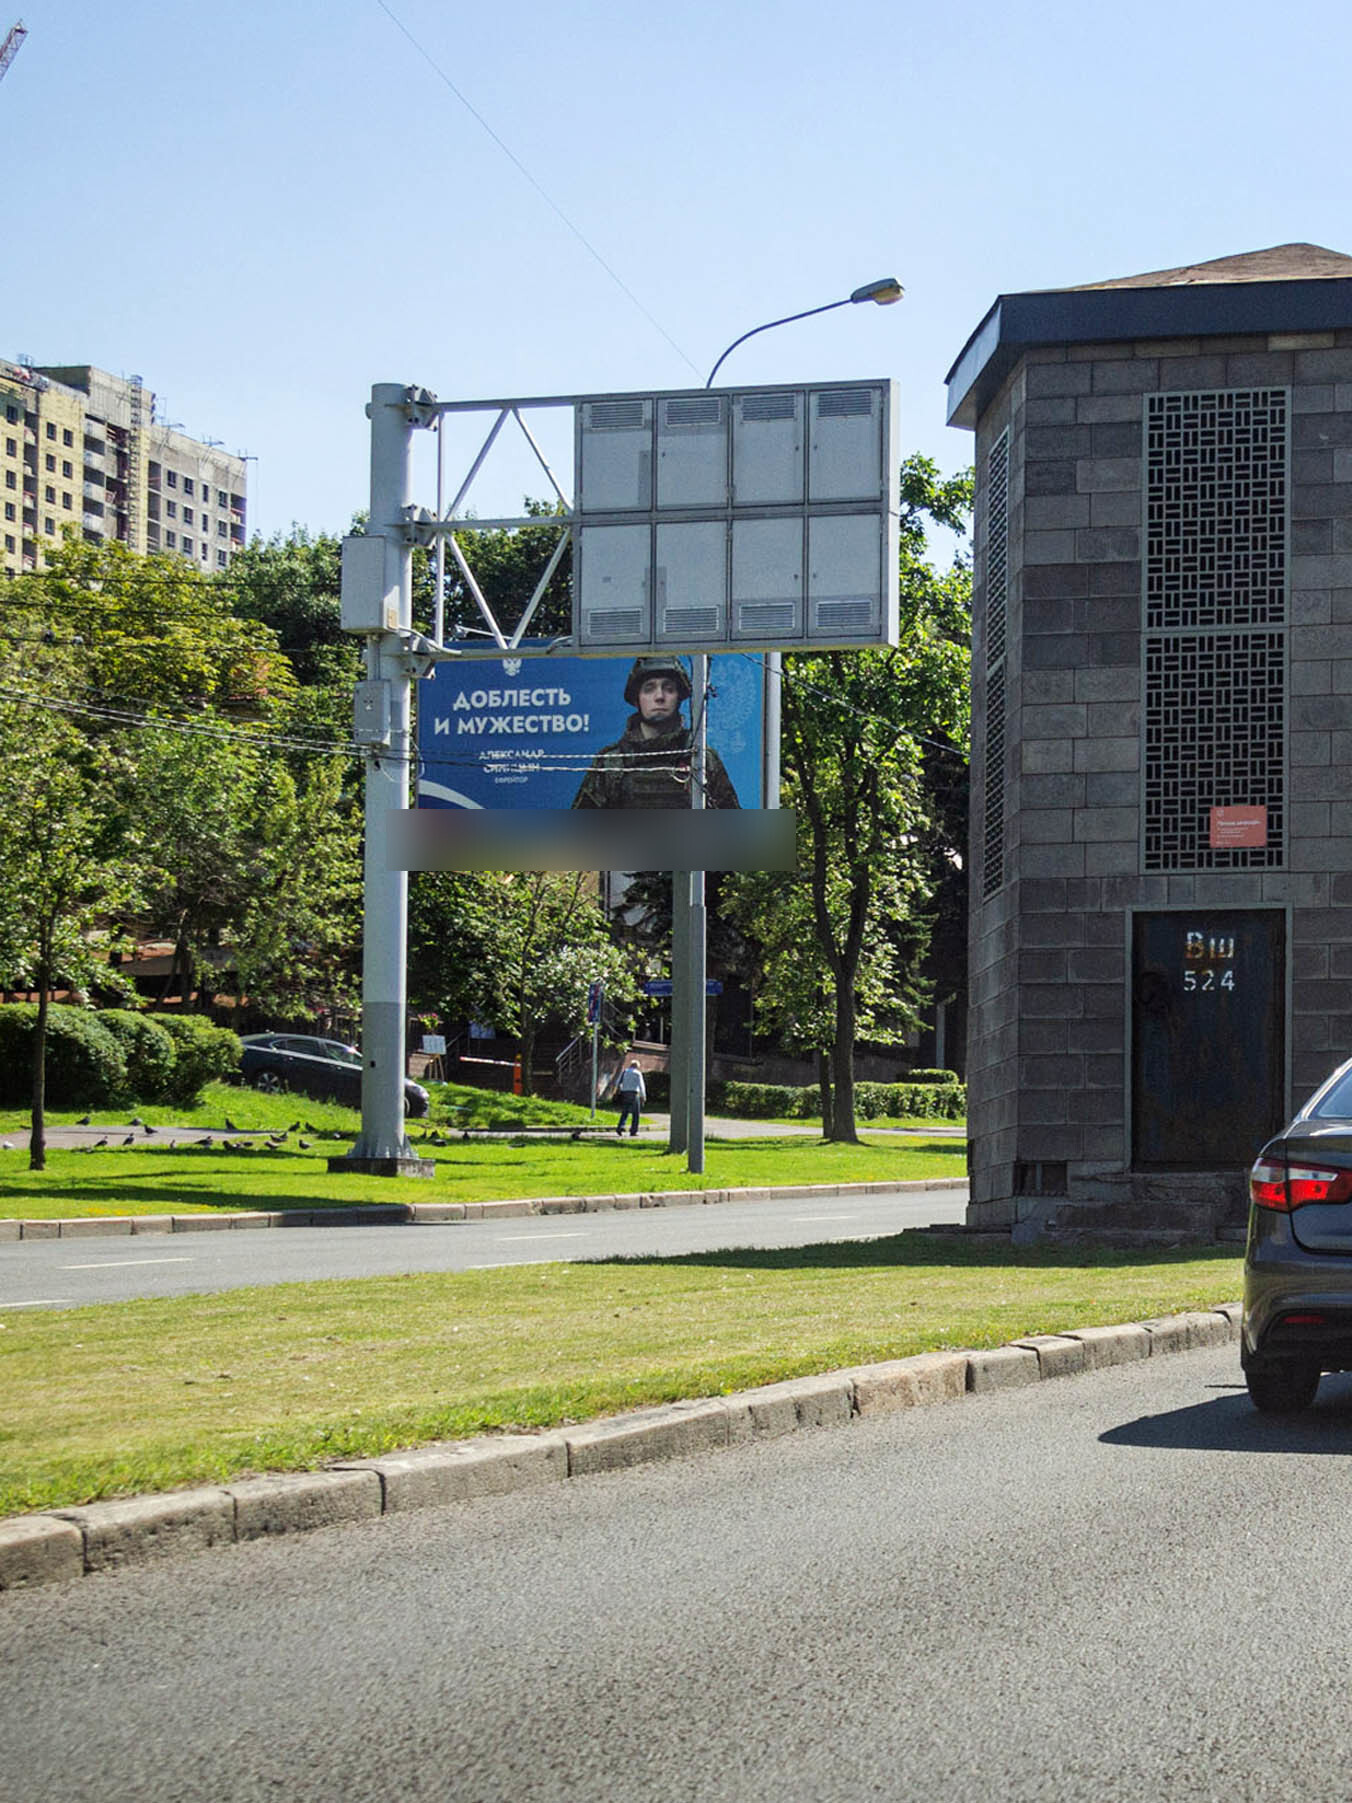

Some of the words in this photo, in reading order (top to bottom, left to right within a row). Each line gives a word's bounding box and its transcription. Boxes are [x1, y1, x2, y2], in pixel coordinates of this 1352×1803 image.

[452, 688, 572, 711] ДОБЛЕСТЬ
[434, 718, 449, 735] И
[457, 714, 589, 735] МУЖЕСТВО!
[1184, 970, 1235, 991] 524
